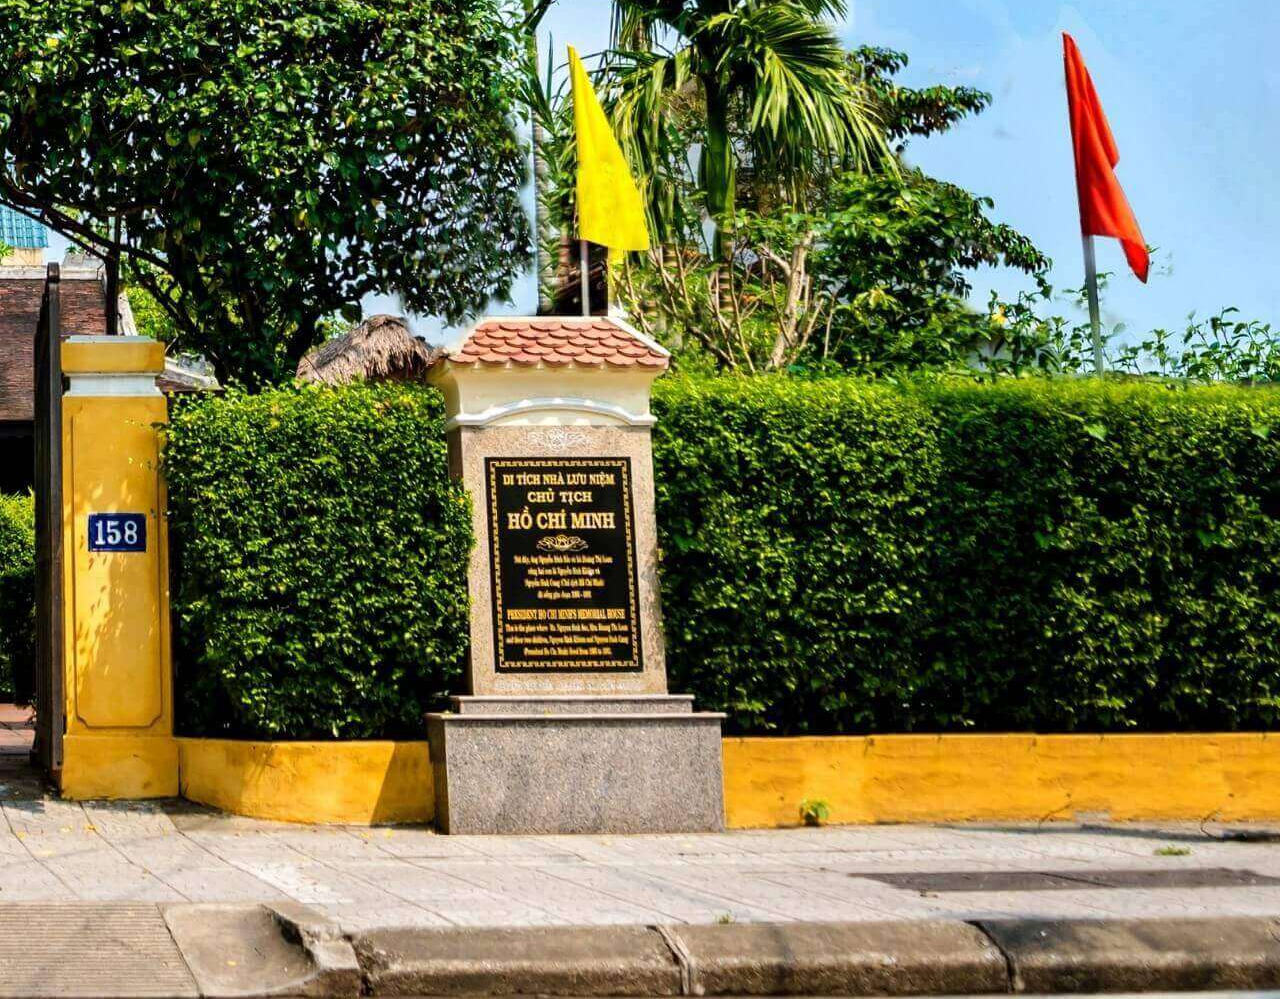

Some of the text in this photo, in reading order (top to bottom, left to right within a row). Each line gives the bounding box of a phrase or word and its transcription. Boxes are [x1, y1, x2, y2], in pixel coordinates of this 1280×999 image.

[502, 471, 616, 488] DI TÍCH NHÀ LƯU NIỆM
[527, 487, 593, 505] CHỦ TỊCH
[507, 505, 616, 530] HỒ CHÍ MINH
[95, 520, 138, 545] 158
